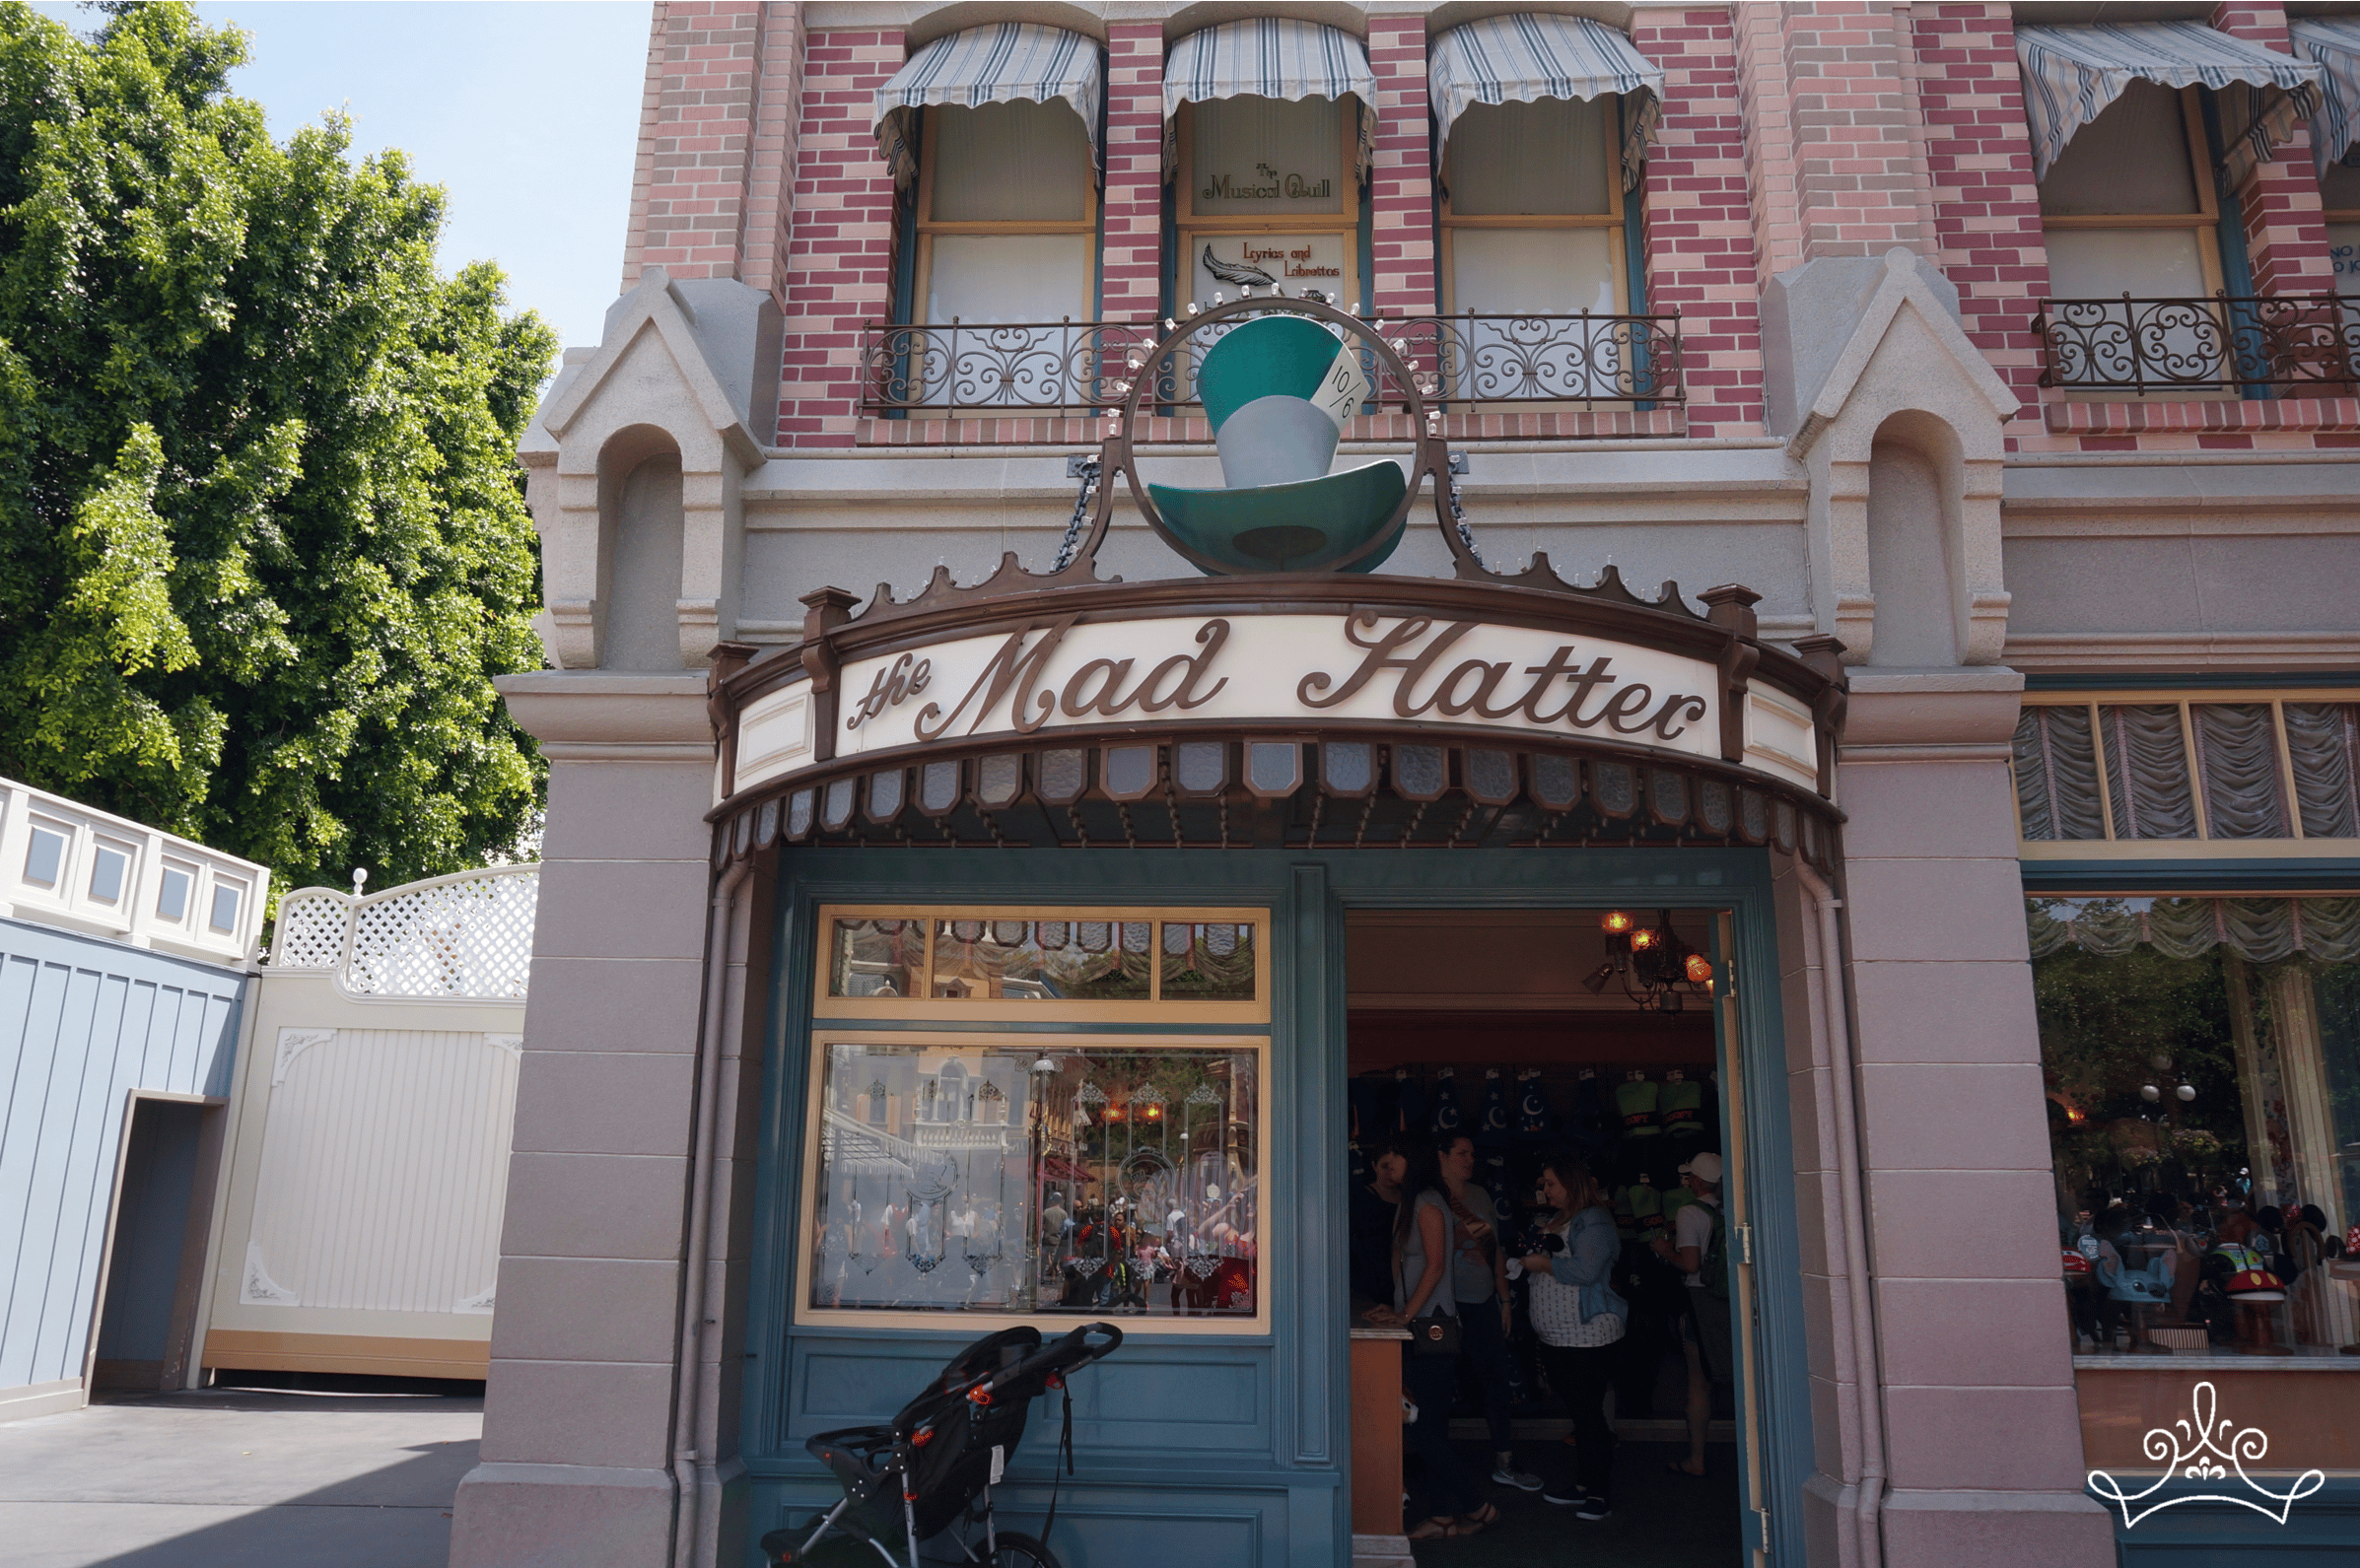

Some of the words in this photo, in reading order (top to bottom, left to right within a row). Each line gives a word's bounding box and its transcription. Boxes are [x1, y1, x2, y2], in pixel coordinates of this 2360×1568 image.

[1202, 173, 1281, 199] Musical
[1284, 172, 1331, 199] Quill
[1243, 241, 1284, 263] Lyrics
[1290, 244, 1311, 262] and
[1284, 260, 1340, 277] Librettos
[846, 651, 932, 730] the
[913, 610, 1230, 742] Mad
[1296, 609, 1706, 741] Hatter
